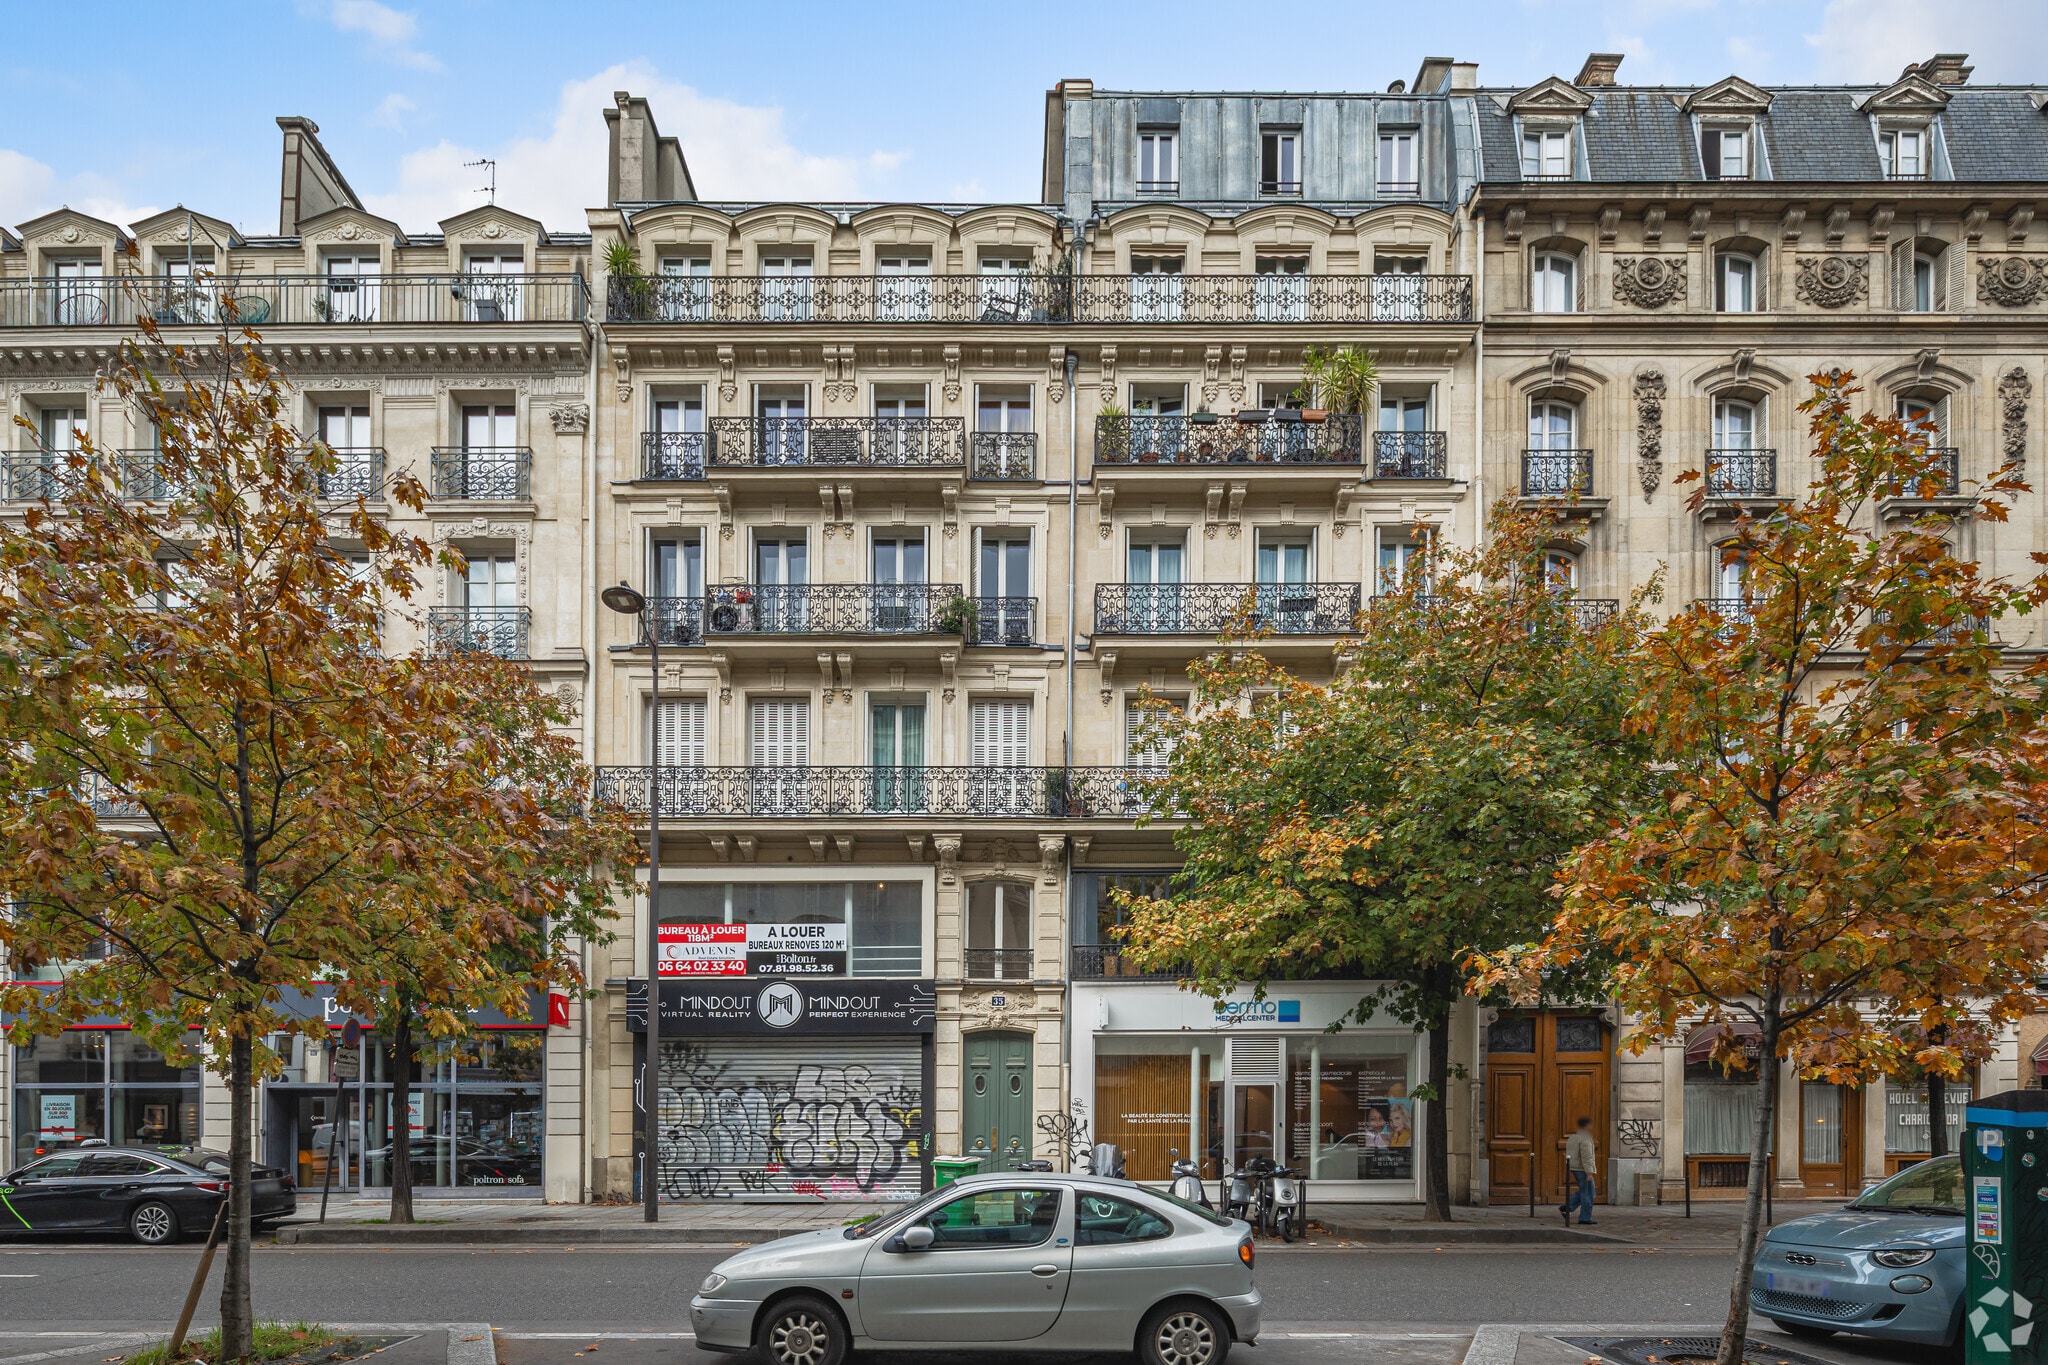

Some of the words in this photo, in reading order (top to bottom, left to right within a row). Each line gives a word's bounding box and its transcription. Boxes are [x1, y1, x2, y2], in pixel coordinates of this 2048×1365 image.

[658, 926, 698, 934] BUREAU
[701, 925, 709, 934] À
[711, 926, 745, 934] LOUER
[768, 926, 777, 937] A
[781, 926, 825, 937] LOUER
[749, 941, 783, 949] BUREAUX
[786, 941, 820, 949] RENOVES
[822, 941, 834, 949] 120
[684, 946, 736, 955] ADVENIS
[658, 961, 673, 971] 06
[675, 961, 691, 971] 64
[694, 961, 709, 971] 02
[711, 961, 725, 971] 33
[727, 961, 744, 971] 40
[759, 964, 834, 973] 07.81.98.52.36
[681, 996, 751, 1010] MINDOUT
[809, 996, 880, 1010] MINDOUT
[993, 997, 1004, 1006] 35
[1889, 1092, 1918, 1104] HOTEL
